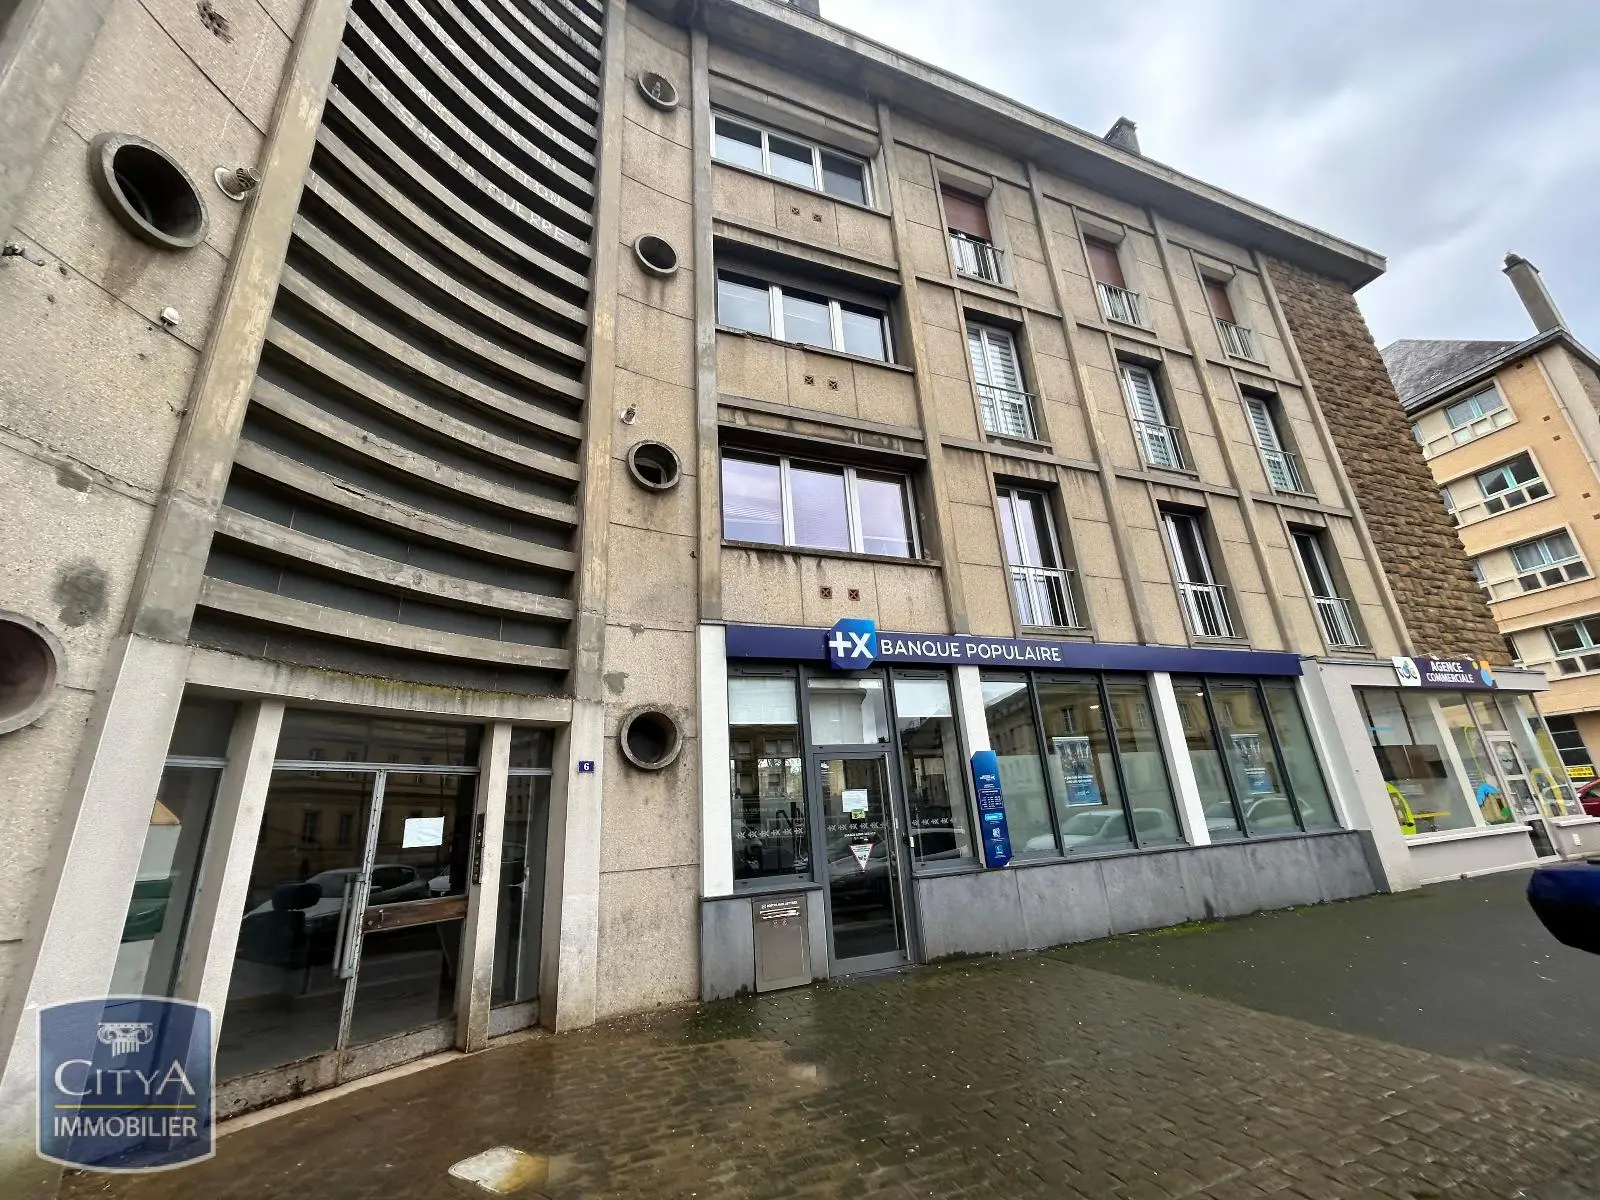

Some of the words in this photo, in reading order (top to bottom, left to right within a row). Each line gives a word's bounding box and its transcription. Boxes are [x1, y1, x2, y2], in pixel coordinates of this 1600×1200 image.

[880, 639, 961, 657] BANQUE
[966, 643, 1062, 661] POPULAIRE
[1430, 661, 1463, 673] AGENCE
[1426, 673, 1475, 683] COMMERCIALE
[583, 762, 590, 771] 6
